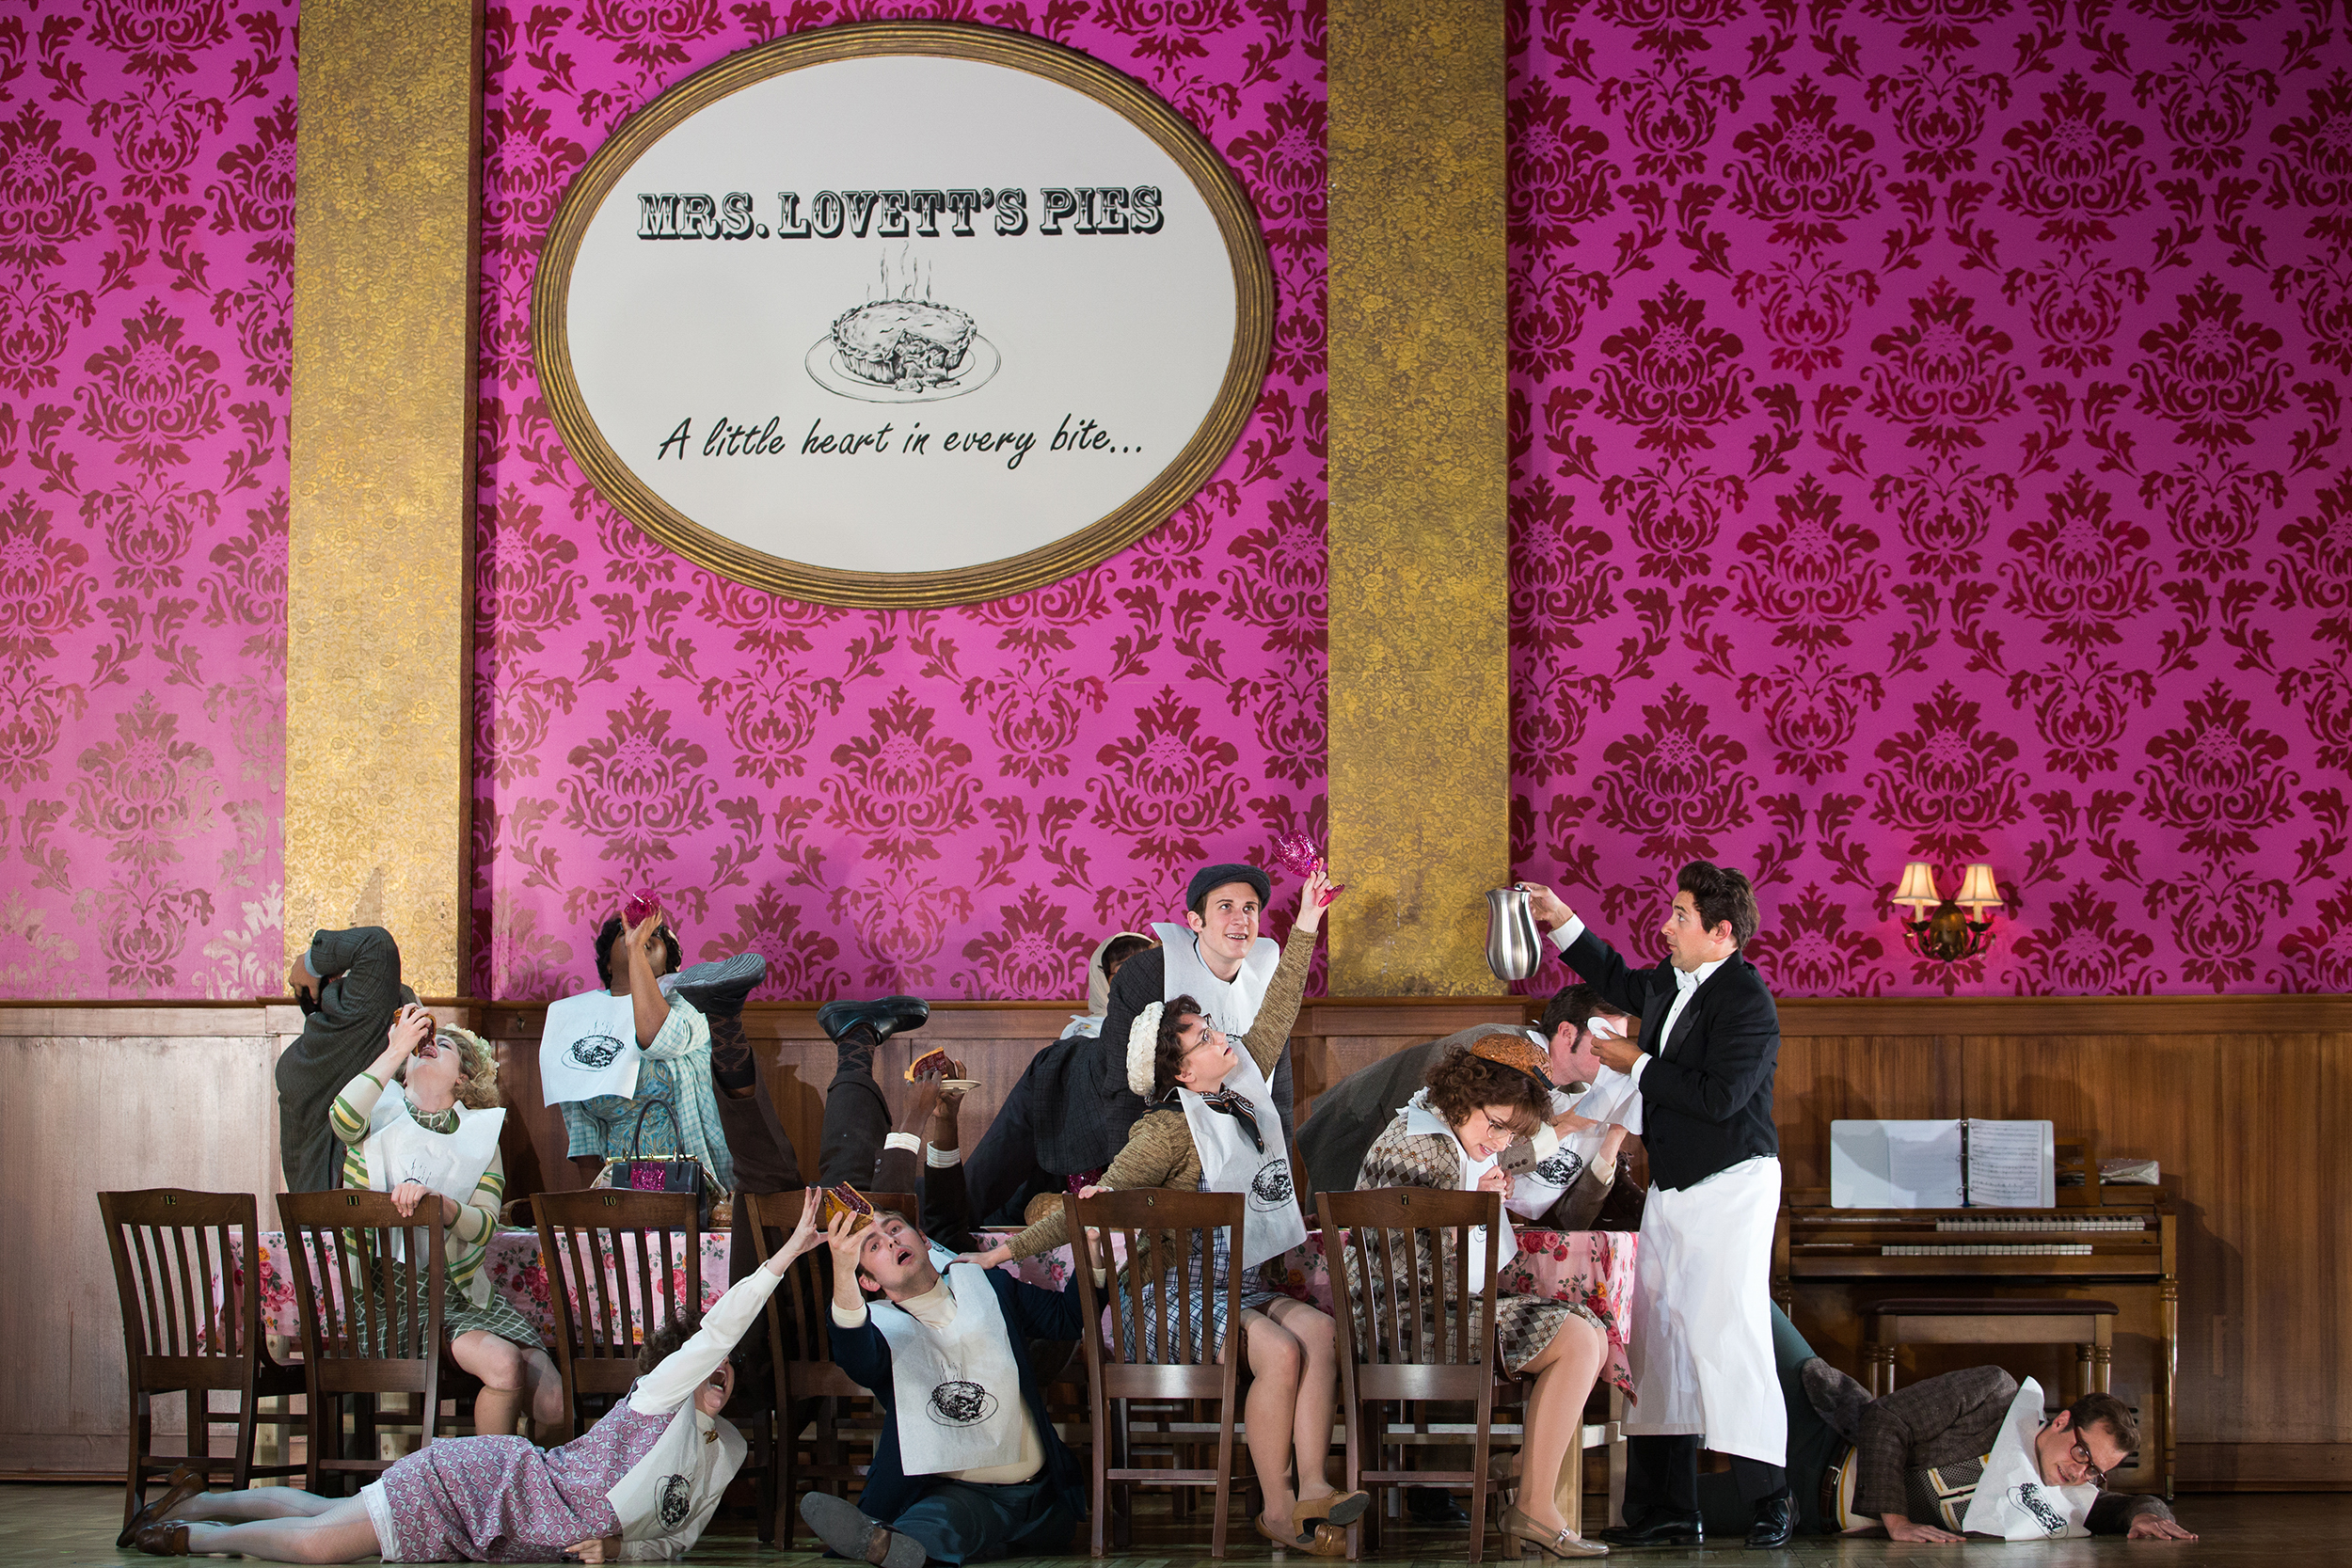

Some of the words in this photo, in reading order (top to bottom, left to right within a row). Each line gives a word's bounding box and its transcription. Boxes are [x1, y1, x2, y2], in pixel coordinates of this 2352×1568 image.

[637, 192, 771, 241] MRS.
[777, 187, 1029, 240] LOVETT'S
[1039, 184, 1165, 236] PIES
[658, 417, 692, 461] A
[703, 416, 786, 457] little
[801, 418, 894, 455] heart
[902, 421, 930, 456] in
[943, 432, 1037, 470] every
[1050, 413, 1142, 453] bite...
[166, 1195, 177, 1205] 12
[603, 1196, 616, 1206] 10
[1147, 1196, 1154, 1206] 8
[1402, 1195, 1408, 1205] 7
